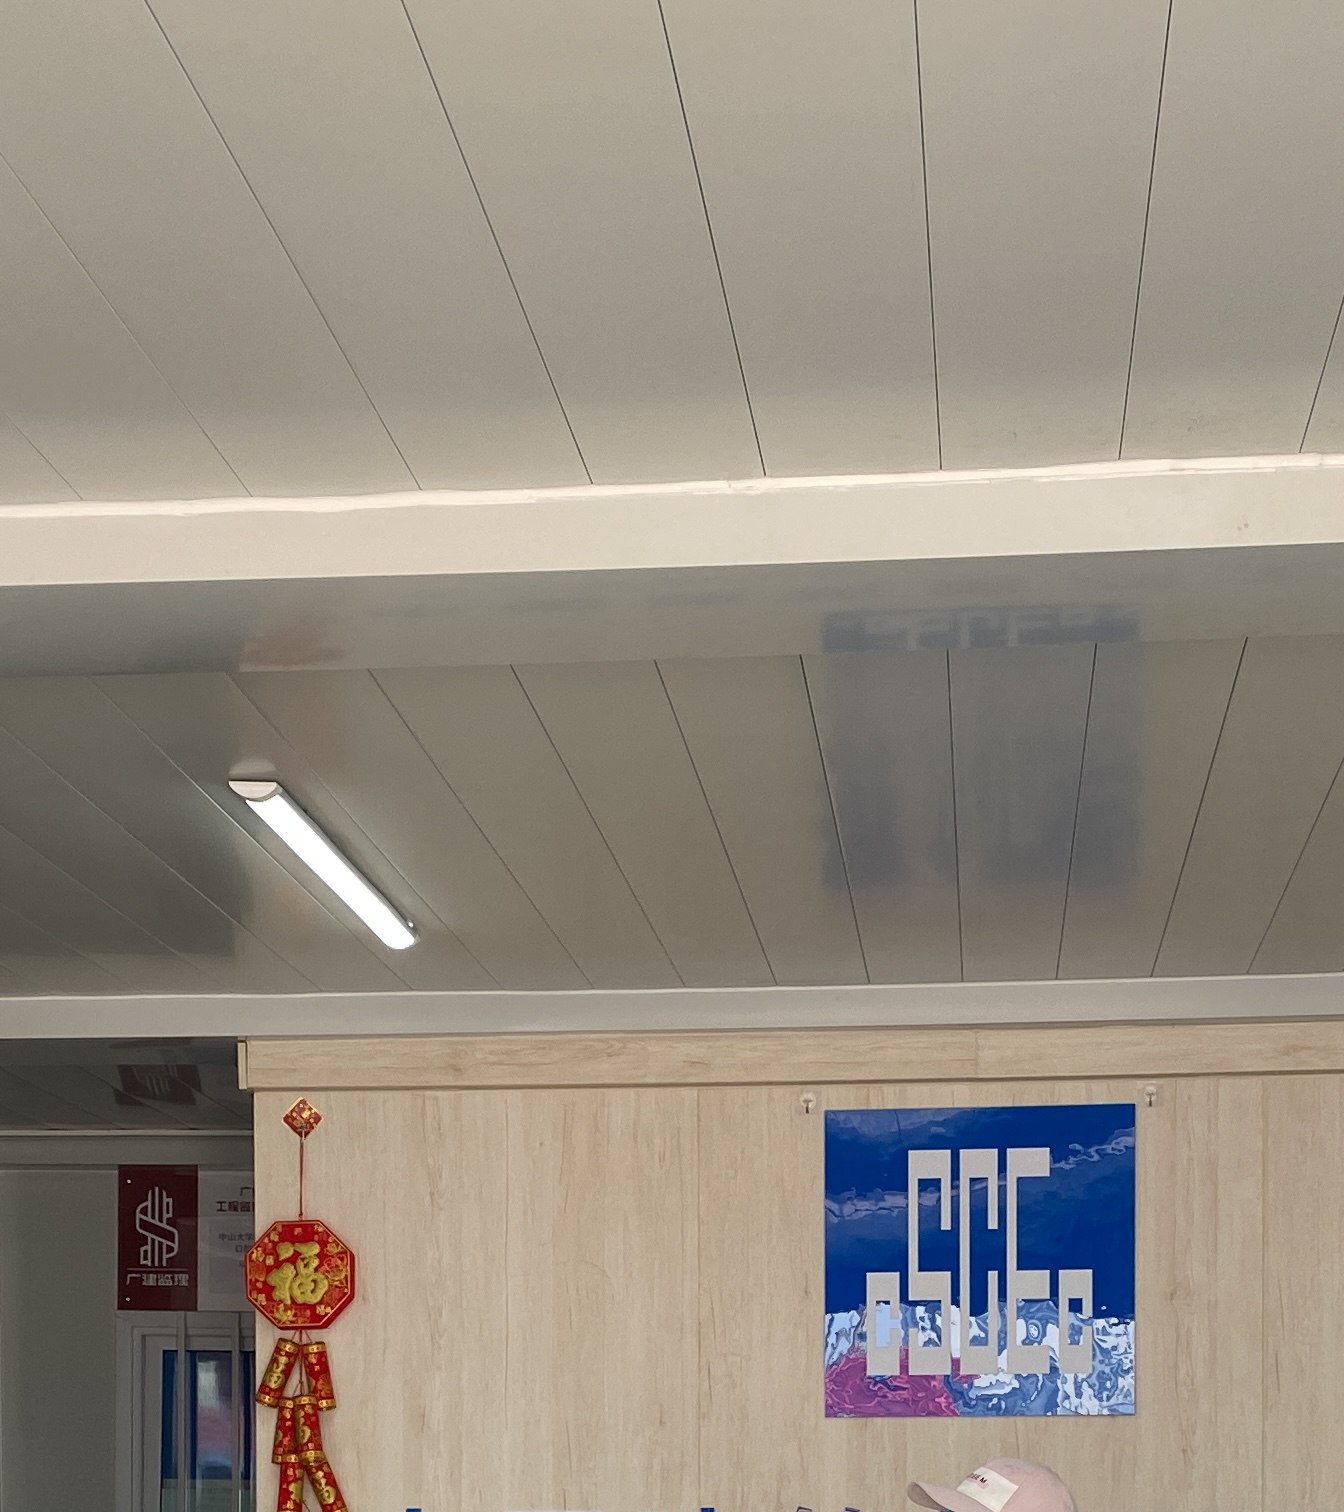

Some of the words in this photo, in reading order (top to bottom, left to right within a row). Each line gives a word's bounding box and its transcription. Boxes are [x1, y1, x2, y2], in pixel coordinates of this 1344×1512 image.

[216, 1201, 255, 1212] 工程监
[266, 1241, 329, 1305] 福
